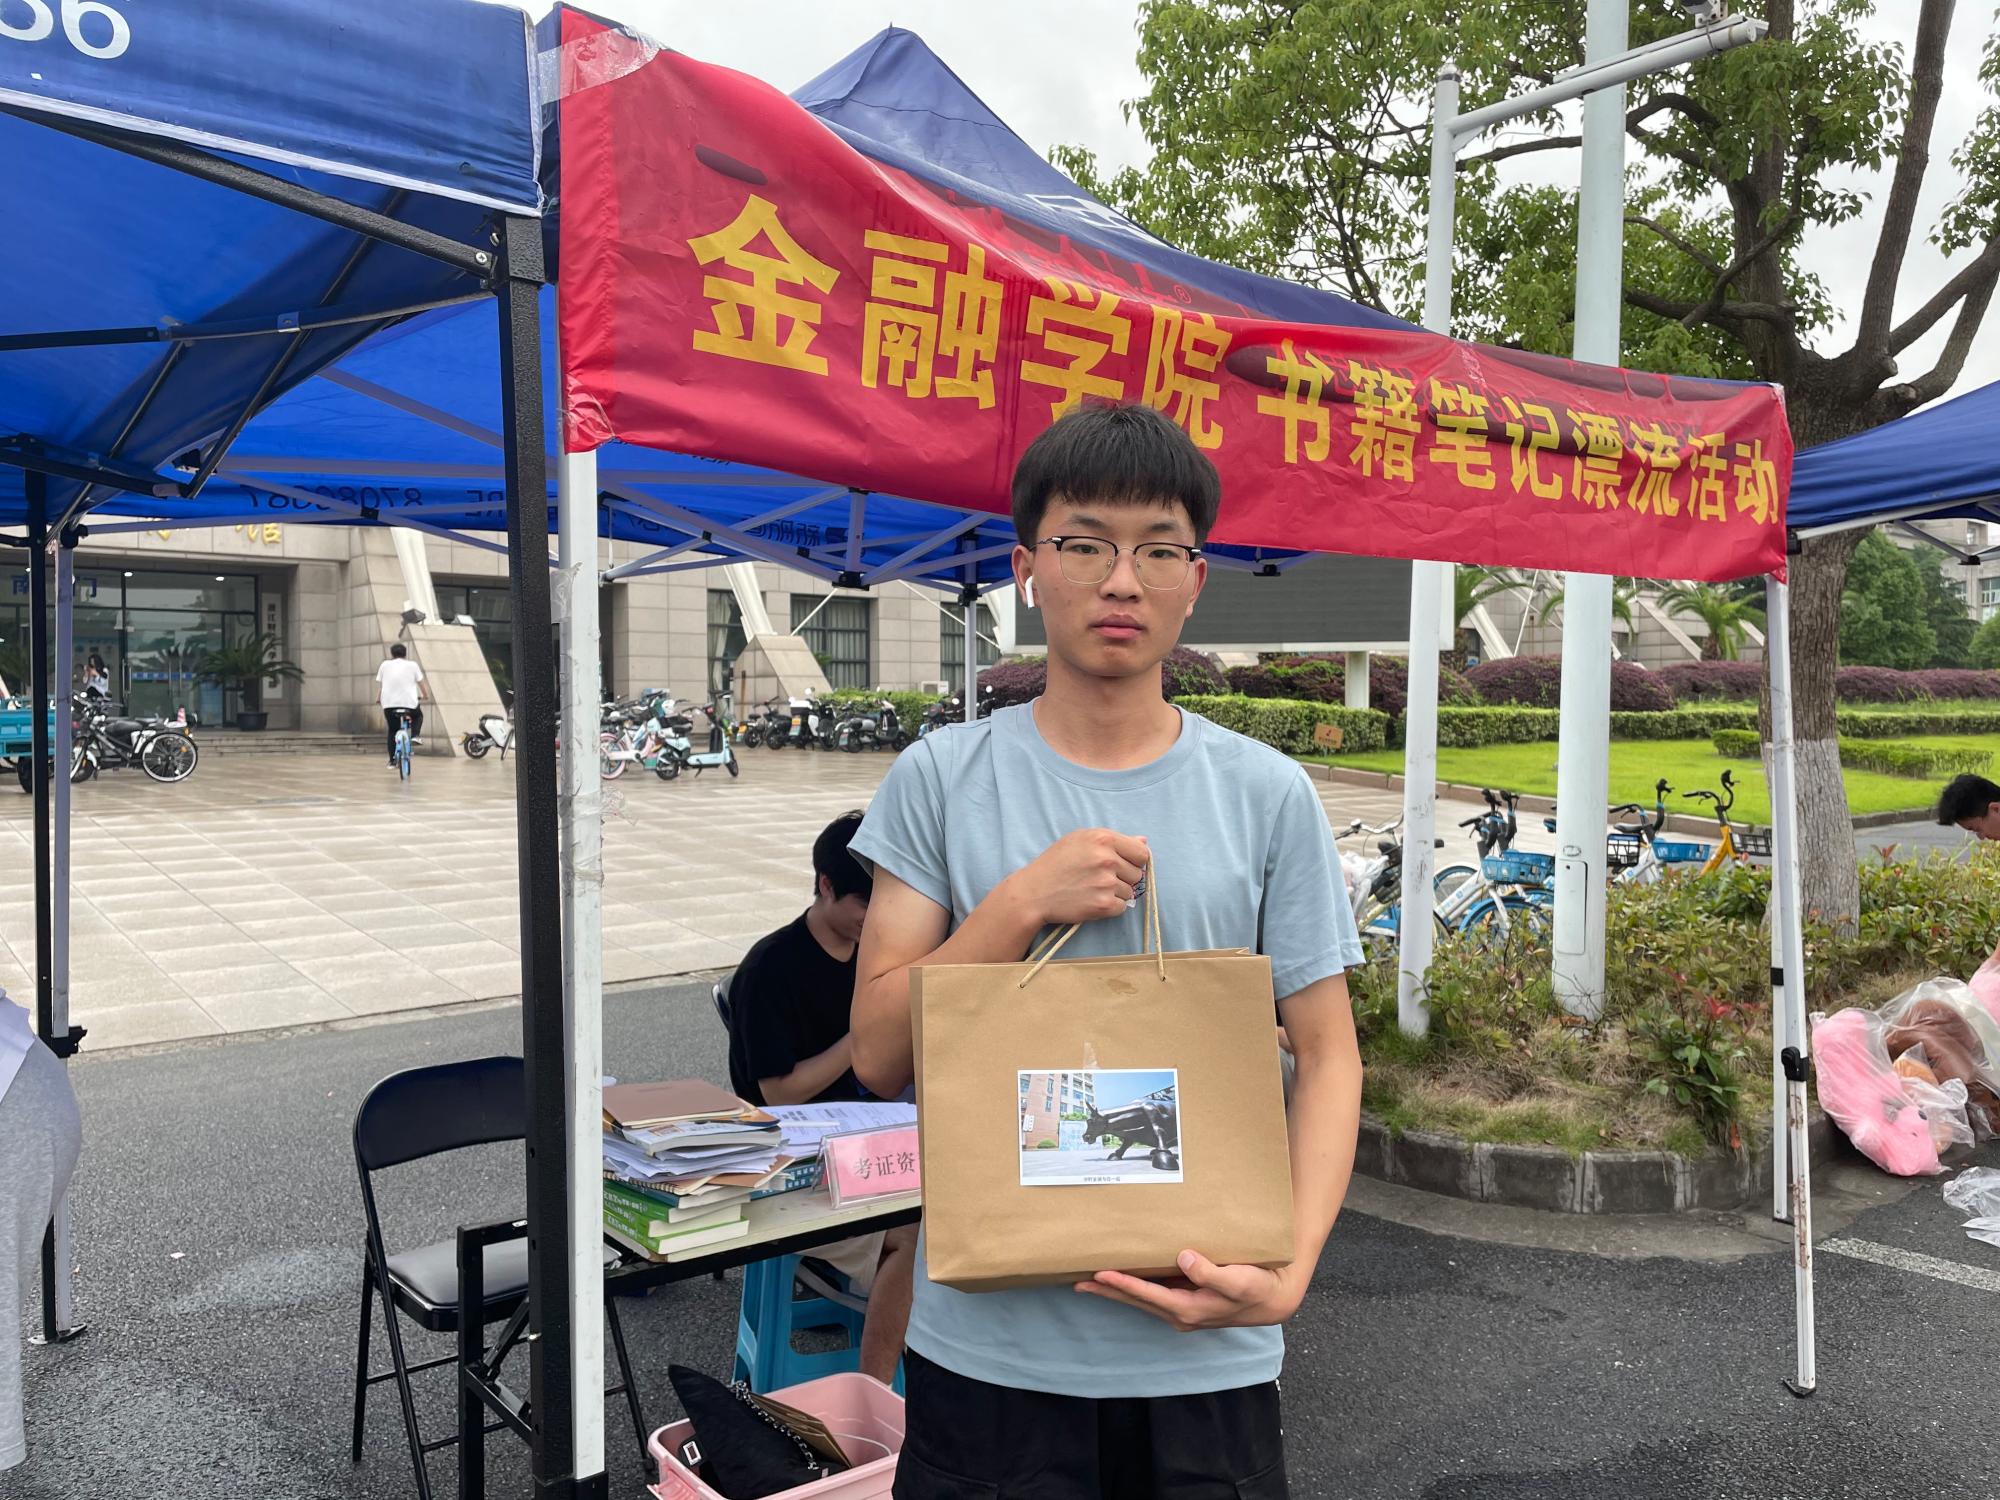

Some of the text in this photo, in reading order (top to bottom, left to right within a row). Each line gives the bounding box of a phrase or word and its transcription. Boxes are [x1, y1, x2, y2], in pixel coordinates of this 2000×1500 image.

[687, 194, 1233, 450] 金融学院
[1257, 339, 1779, 525] 书籍笔记漂流活动
[853, 1151, 920, 1180] 考证资
